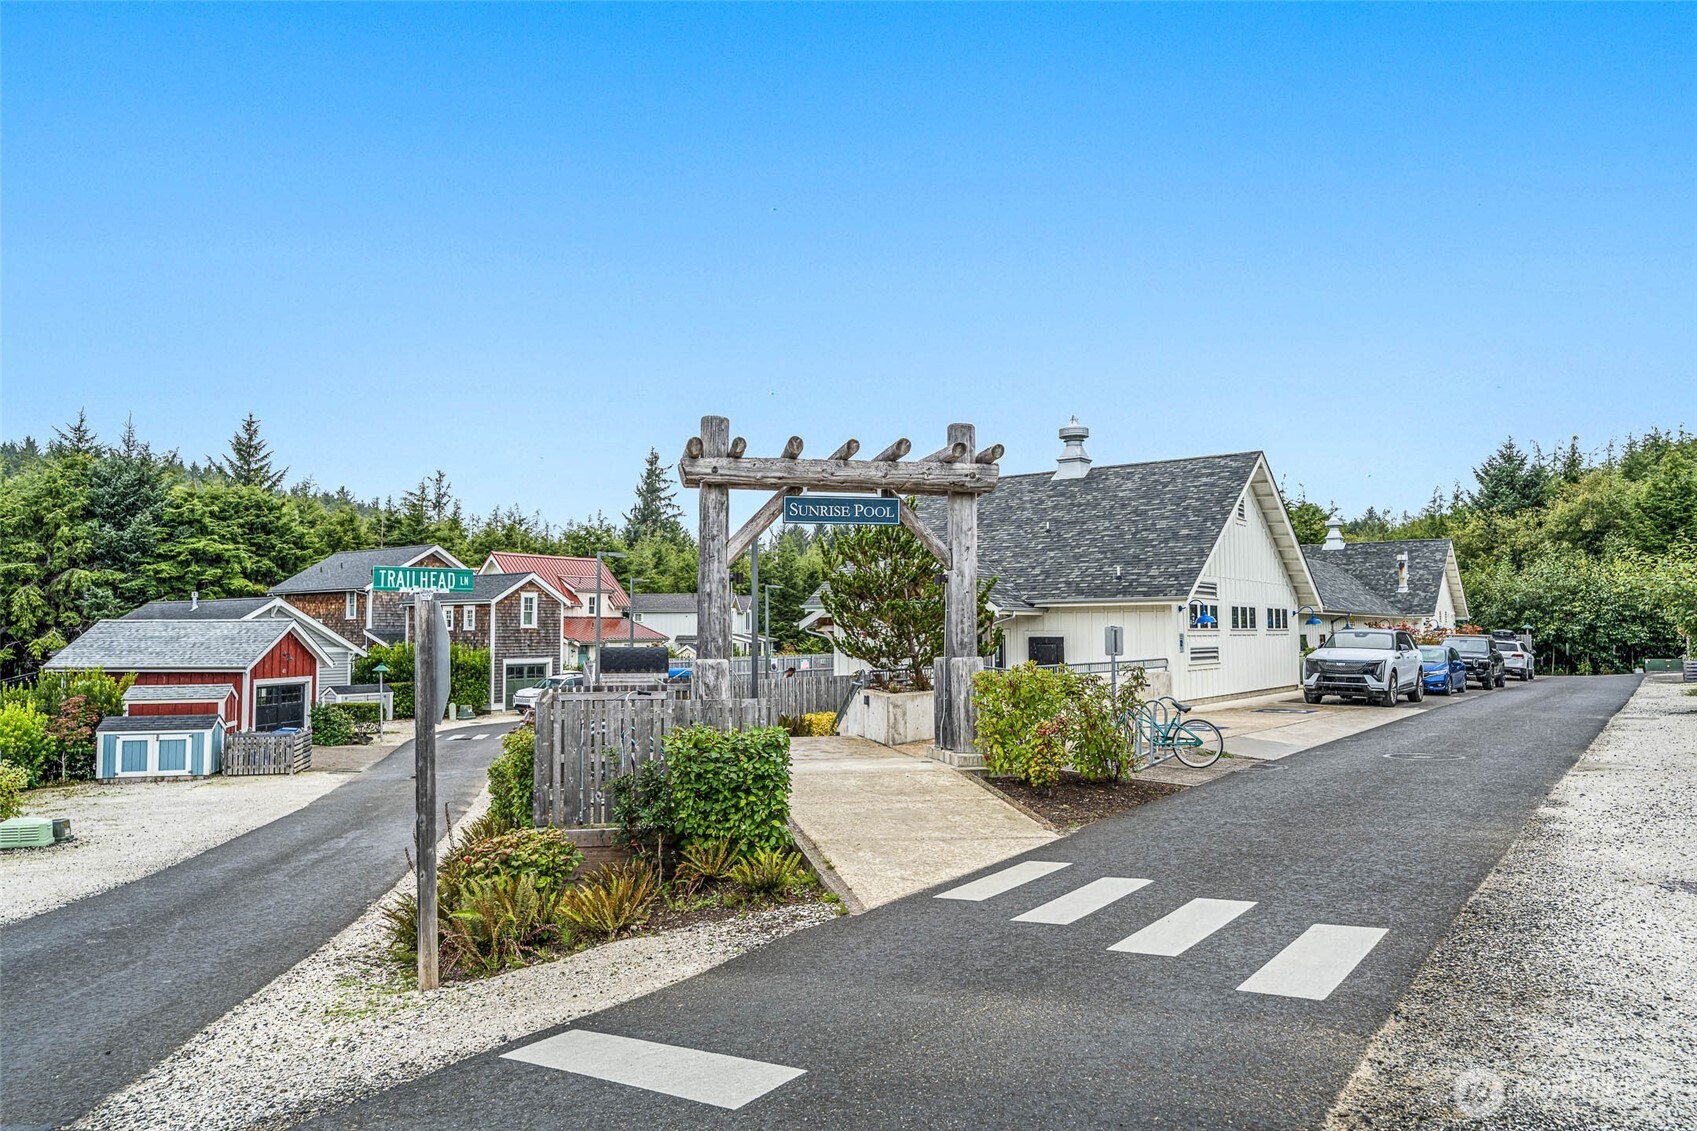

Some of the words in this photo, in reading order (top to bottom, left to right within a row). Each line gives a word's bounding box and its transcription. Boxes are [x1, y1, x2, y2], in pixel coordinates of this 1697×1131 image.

[789, 502, 850, 517] SUNRISE
[853, 503, 895, 518] POOL
[379, 569, 456, 589] TRAILHEAD
[460, 576, 469, 586] LN
